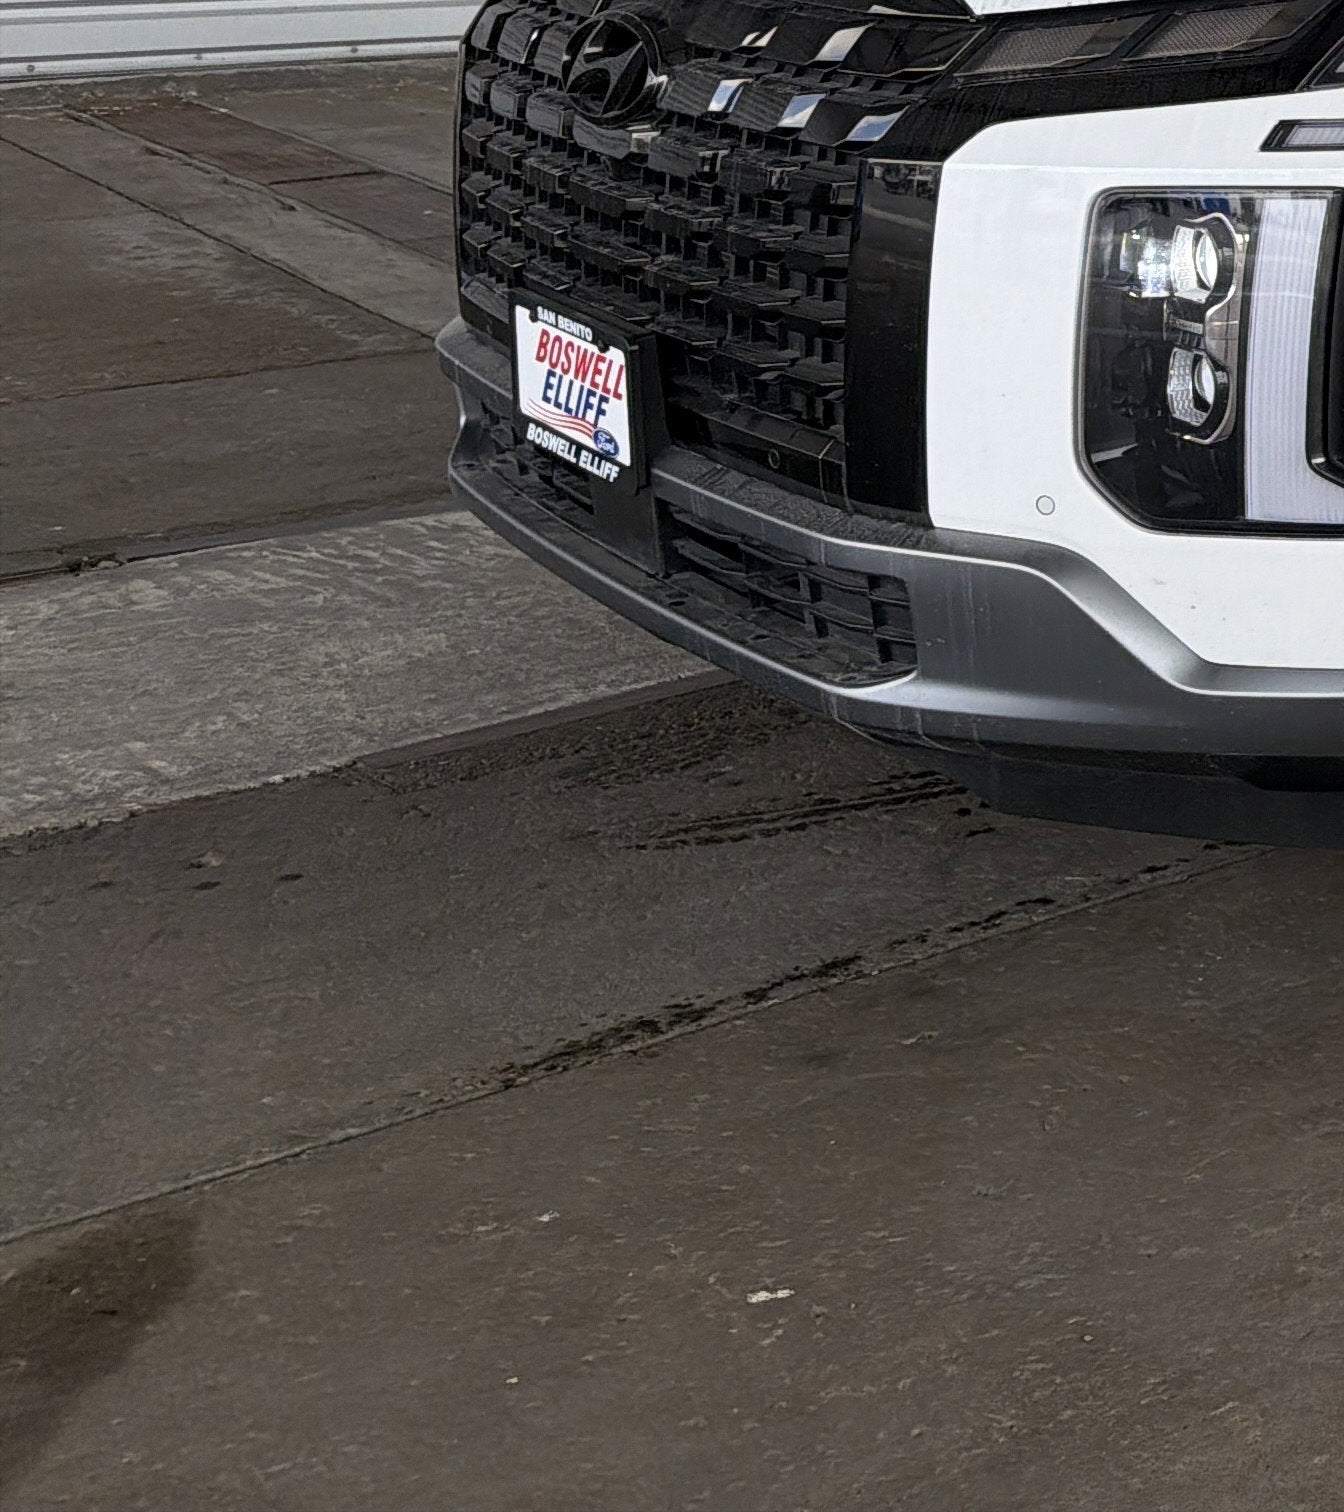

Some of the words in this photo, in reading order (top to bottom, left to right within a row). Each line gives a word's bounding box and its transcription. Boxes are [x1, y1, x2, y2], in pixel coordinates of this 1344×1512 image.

[537, 306, 556, 326] SAN
[557, 315, 593, 341] BENITO
[535, 328, 625, 400] BOSWELL
[541, 368, 610, 427] ELLIFF
[526, 423, 579, 464] BOSWELL
[578, 449, 620, 483] ELLIFF
